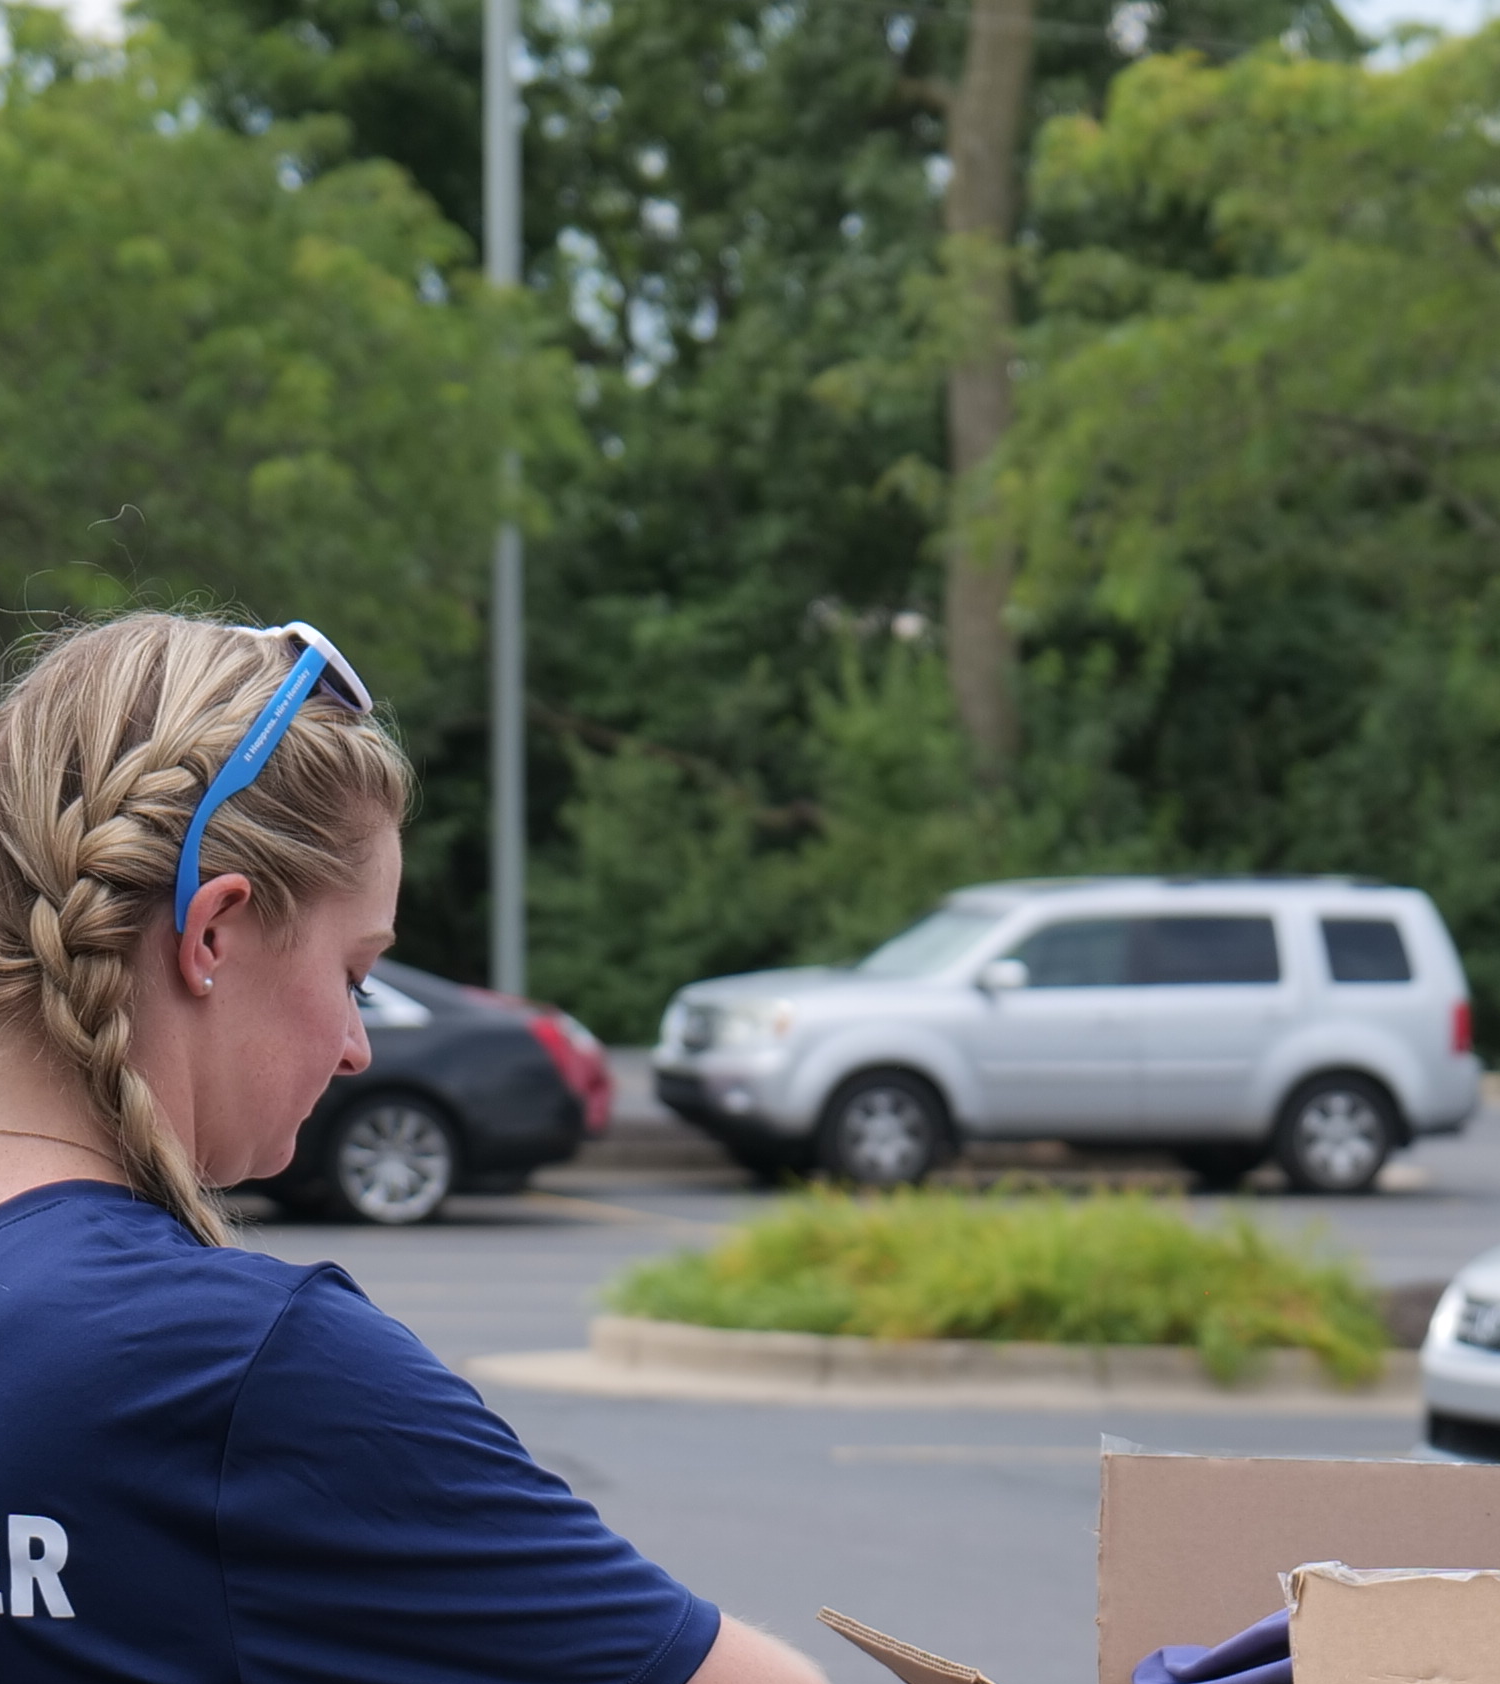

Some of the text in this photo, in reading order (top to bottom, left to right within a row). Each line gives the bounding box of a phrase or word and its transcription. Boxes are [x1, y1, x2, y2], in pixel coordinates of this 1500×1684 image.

[243, 667, 310, 763] It Happens. Hire Hensley
